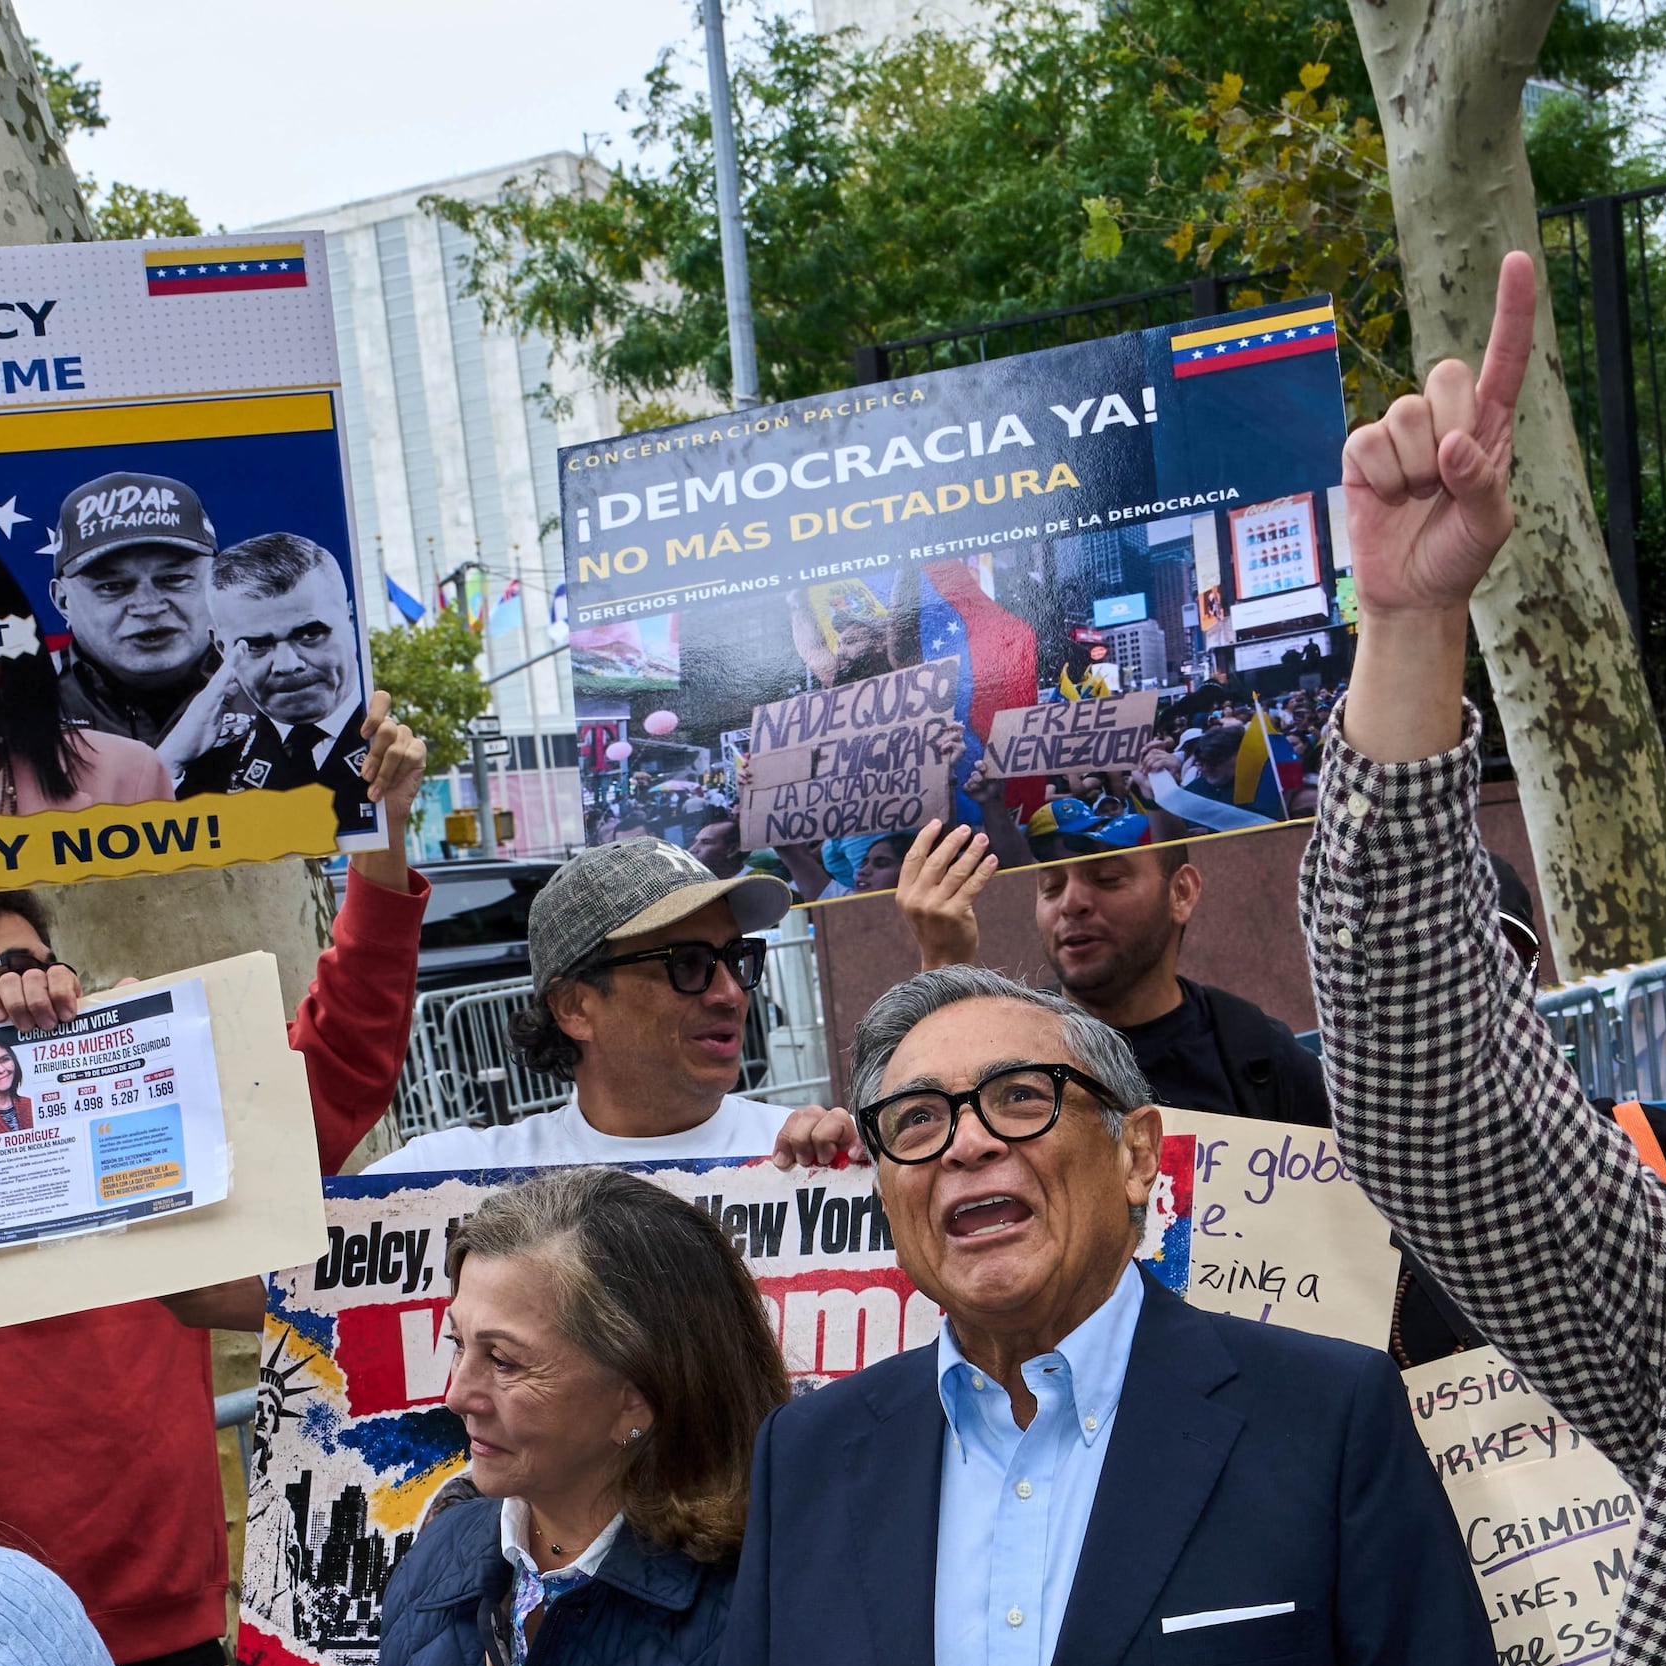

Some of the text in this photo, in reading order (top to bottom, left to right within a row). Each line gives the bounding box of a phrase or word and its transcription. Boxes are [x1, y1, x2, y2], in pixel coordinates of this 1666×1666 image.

[568, 388, 926, 471] CONCENTRACIÓN PACÍFICA
[576, 388, 1159, 543] ¡DEMOCRACIA YA!
[76, 486, 180, 526] DUDAR
[578, 463, 1080, 583] NO MÁS DICTADURA
[80, 521, 96, 540] ES
[578, 487, 1239, 623] DERECHOS HUMANOS LIBERTAD RESTITUCIÓN DE LA DEMOCRACIA
[1022, 697, 1119, 733] FREE
[818, 718, 948, 780] EMIGRAR
[774, 767, 921, 810] LA DICTADURA
[53, 815, 222, 866] NOW!
[766, 807, 818, 843] NOS
[90, 1009, 120, 1029] VITAE
[33, 1028, 134, 1062] 17.849 MUERTES
[34, 1037, 170, 1074] ATRIBUIBLES A FUERZAS DE SEGURIDAD
[101, 1066, 117, 1075] MAYO
[74, 1097, 103, 1112] 4.998
[79, 1087, 94, 1095] 2017
[112, 1090, 139, 1106] 5.287
[148, 1081, 174, 1099] 1.569
[38, 1103, 66, 1119] 5.995
[5, 1128, 60, 1147] RODRÍGUEZ
[52, 1137, 75, 1146] MADURO
[314, 1220, 434, 1294] Delcy,
